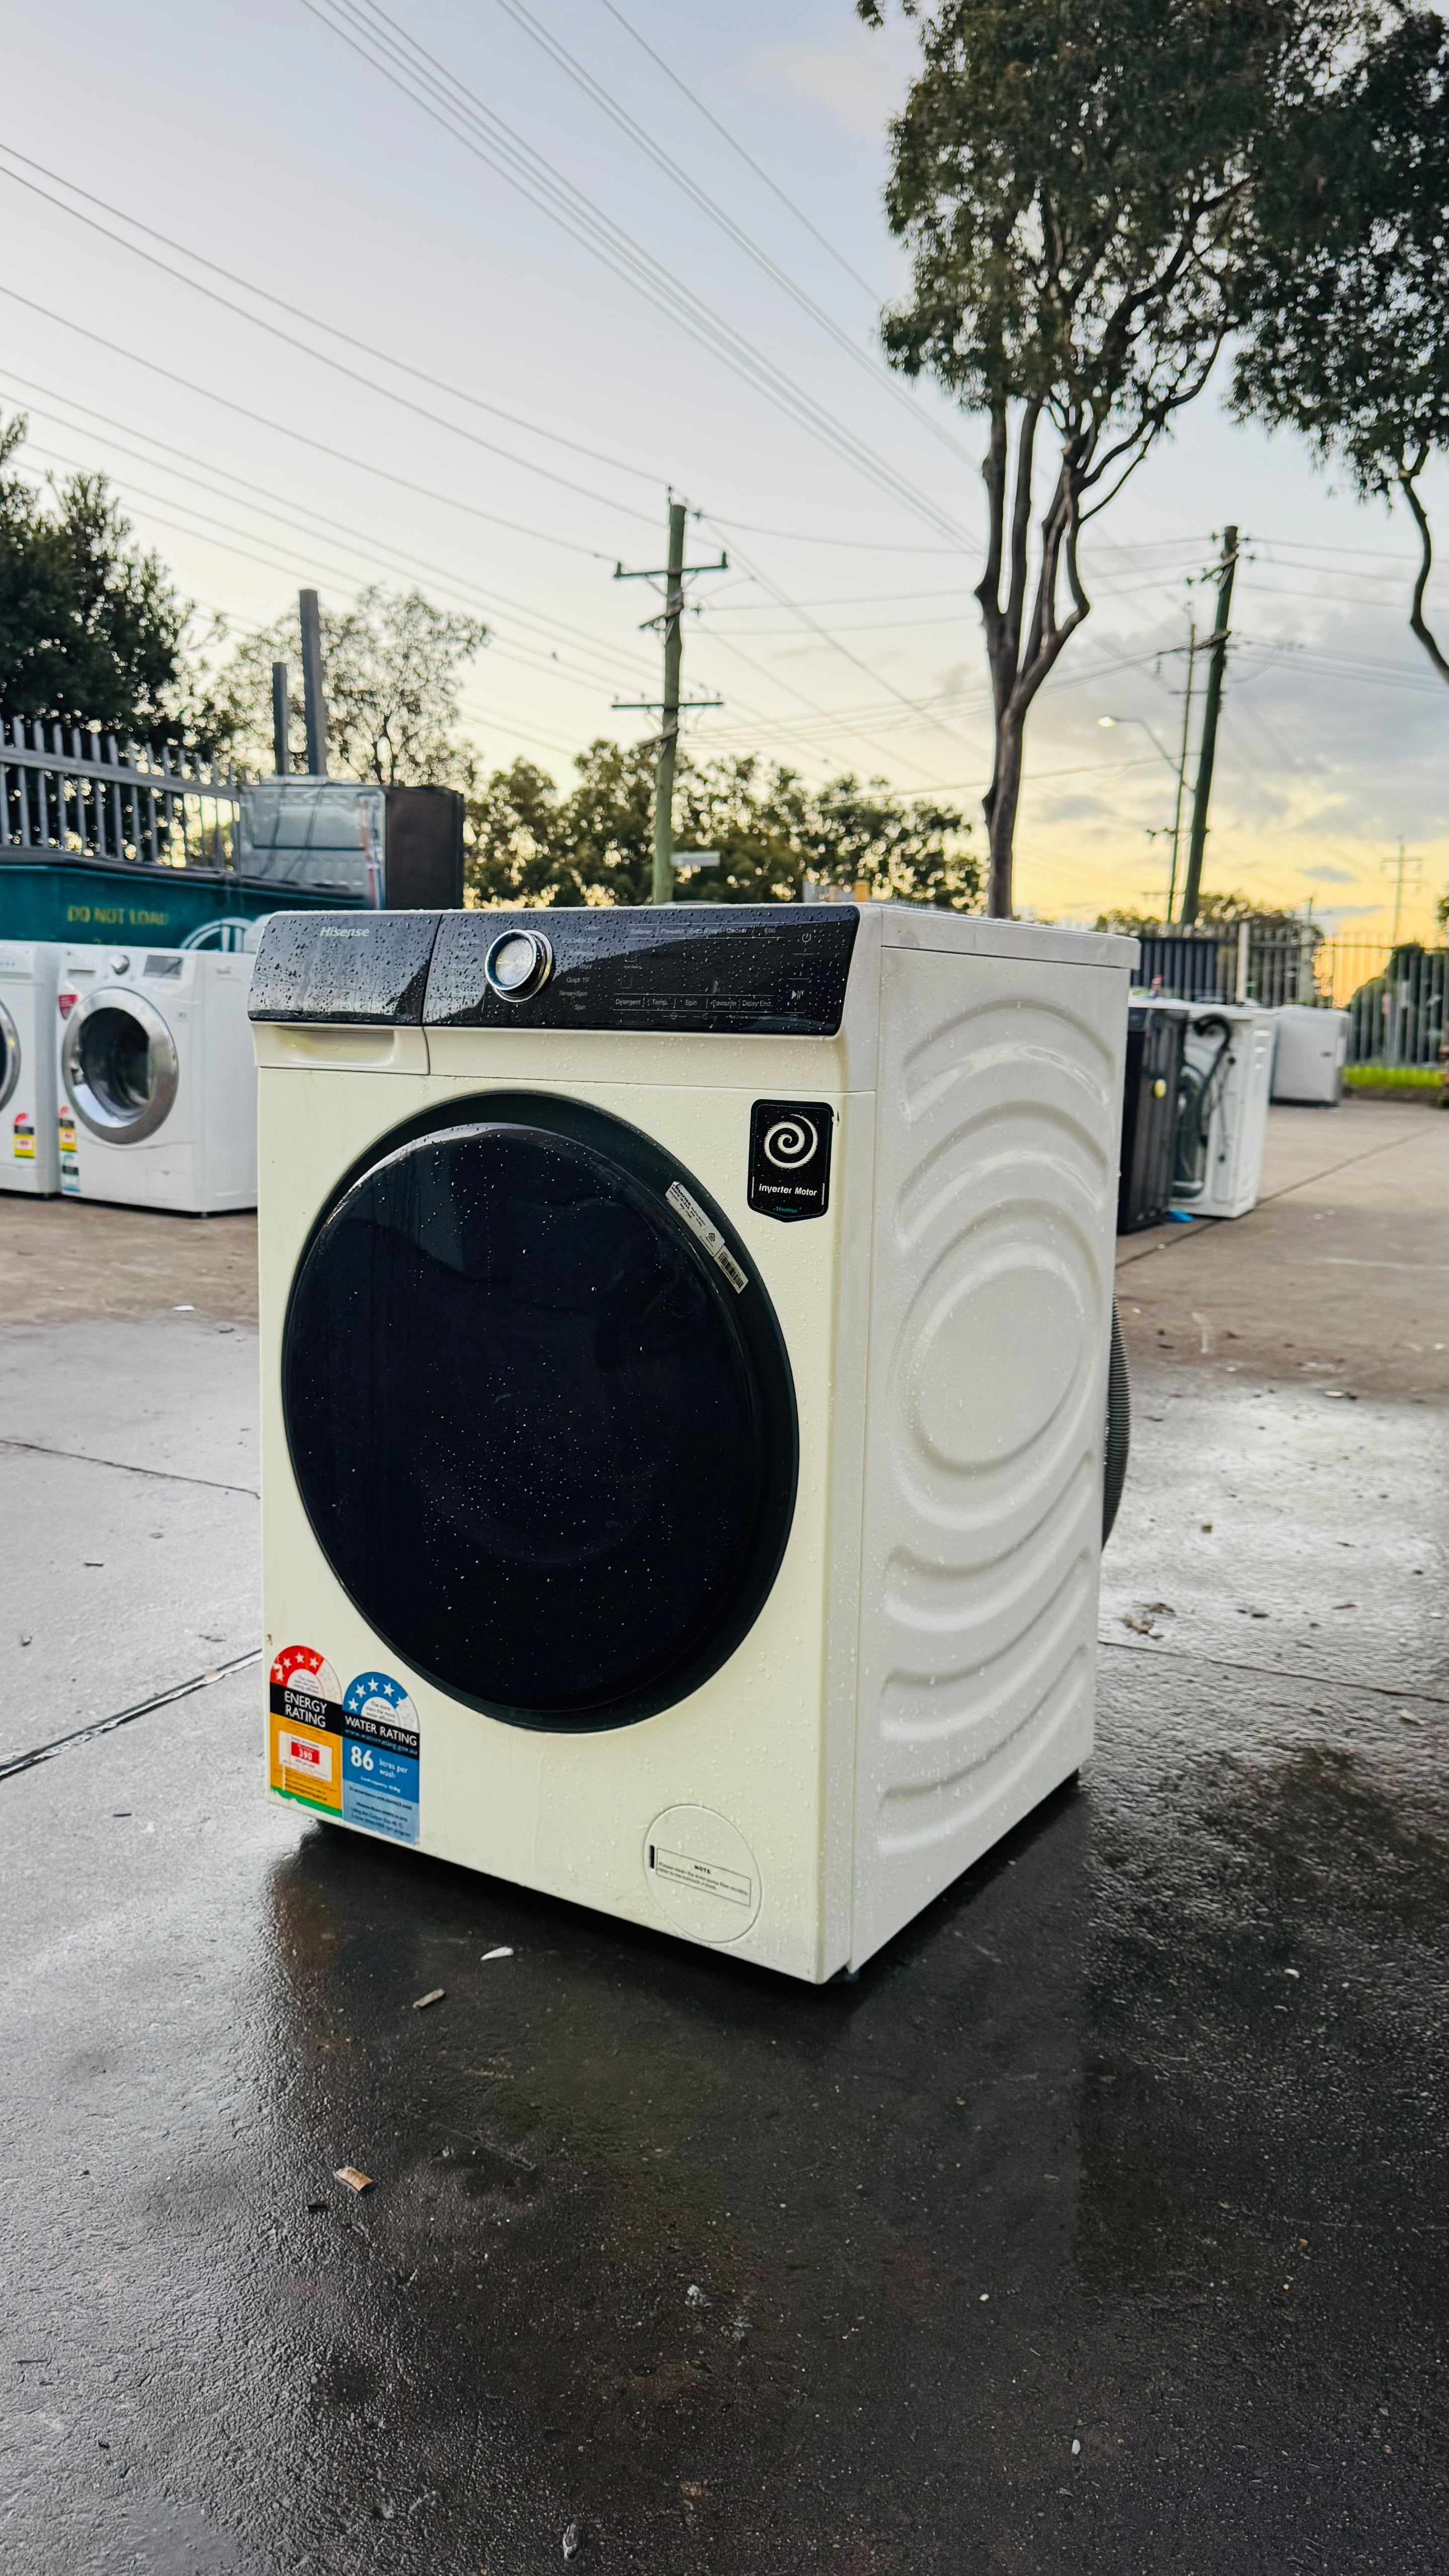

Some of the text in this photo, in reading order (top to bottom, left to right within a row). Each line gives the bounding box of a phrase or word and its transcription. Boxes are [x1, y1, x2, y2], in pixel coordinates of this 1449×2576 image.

[67, 905, 90, 923] DO
[94, 907, 125, 924] NOT
[319, 926, 370, 937] Hisense
[759, 1183, 818, 1196] inverter Motor
[285, 1691, 327, 1714] ENERGY
[285, 1705, 326, 1728] RATING
[345, 1715, 377, 1734] WATER
[380, 1726, 417, 1746] RATING
[298, 1749, 312, 1761] 390
[351, 1745, 374, 1771] 86
[379, 1769, 395, 1779] wash
[396, 1765, 408, 1774] per
